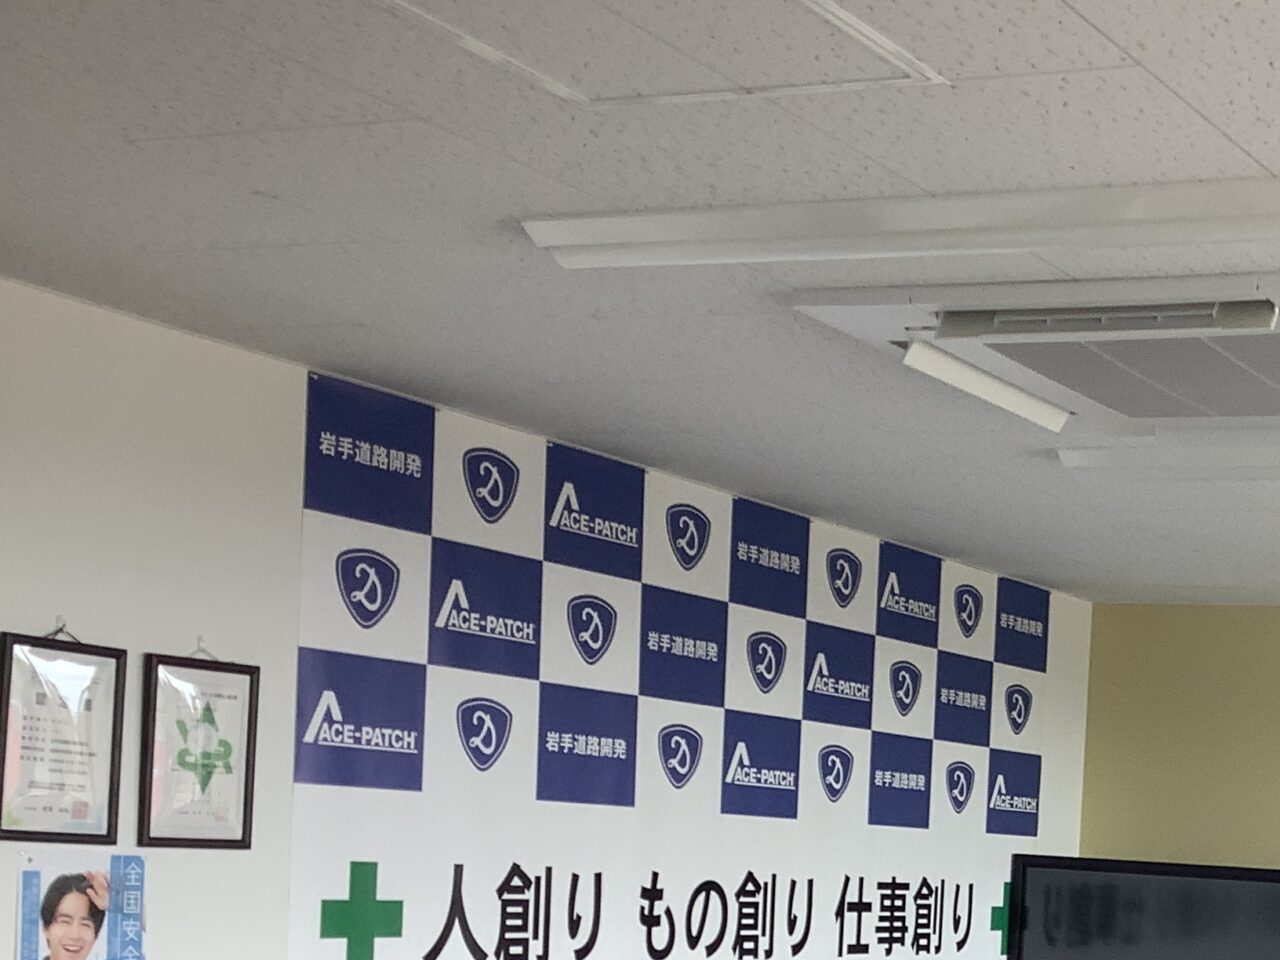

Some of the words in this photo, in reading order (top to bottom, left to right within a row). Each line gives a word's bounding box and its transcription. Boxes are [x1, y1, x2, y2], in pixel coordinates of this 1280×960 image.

[320, 432, 421, 477] 岩手道路開発
[549, 482, 638, 547] ACE-PATCH
[737, 542, 800, 574] 岩手道路開発
[435, 579, 535, 644] ACE-PATCH
[880, 572, 935, 621] ACE-PATCH
[648, 632, 717, 661] 岩手道路開発
[1000, 614, 1042, 636] 岩手道路開発
[807, 653, 869, 701] ACE-PATCH
[941, 688, 986, 710] 岩手道路開発
[303, 691, 418, 753] ACE-PATCH
[546, 732, 626, 759] 岩手道路開発
[725, 742, 795, 789] ACE-PATCH
[875, 770, 925, 790] 岩手道路開発
[990, 775, 1036, 812] ACE-PATCH
[640, 871, 813, 960] もの創り
[835, 875, 973, 957] 仕事創り
